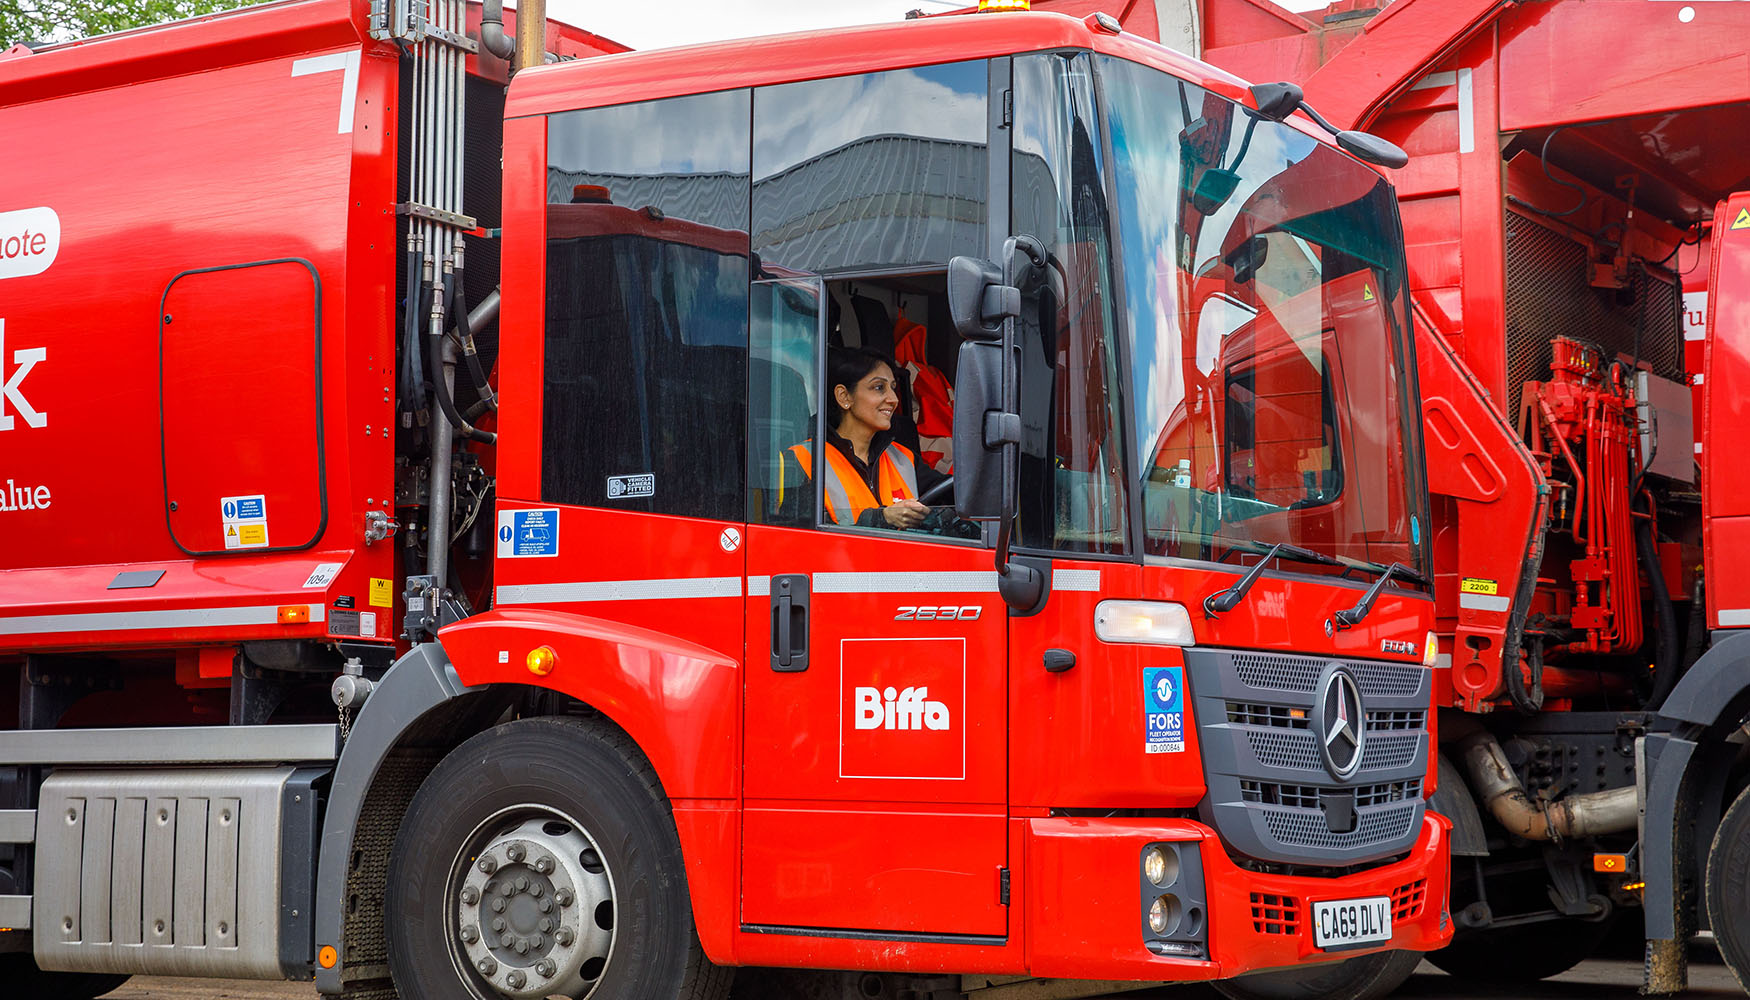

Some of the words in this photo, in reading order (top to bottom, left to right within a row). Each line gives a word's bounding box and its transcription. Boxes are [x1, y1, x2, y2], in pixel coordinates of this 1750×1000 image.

[307, 574, 325, 585] 109
[1470, 583, 1489, 592] 2200
[894, 605, 983, 621] 2630
[855, 686, 950, 730] Biffa
[1149, 713, 1181, 730] FORS
[1321, 906, 1356, 939] CA69
[1361, 904, 1384, 935] DLV
